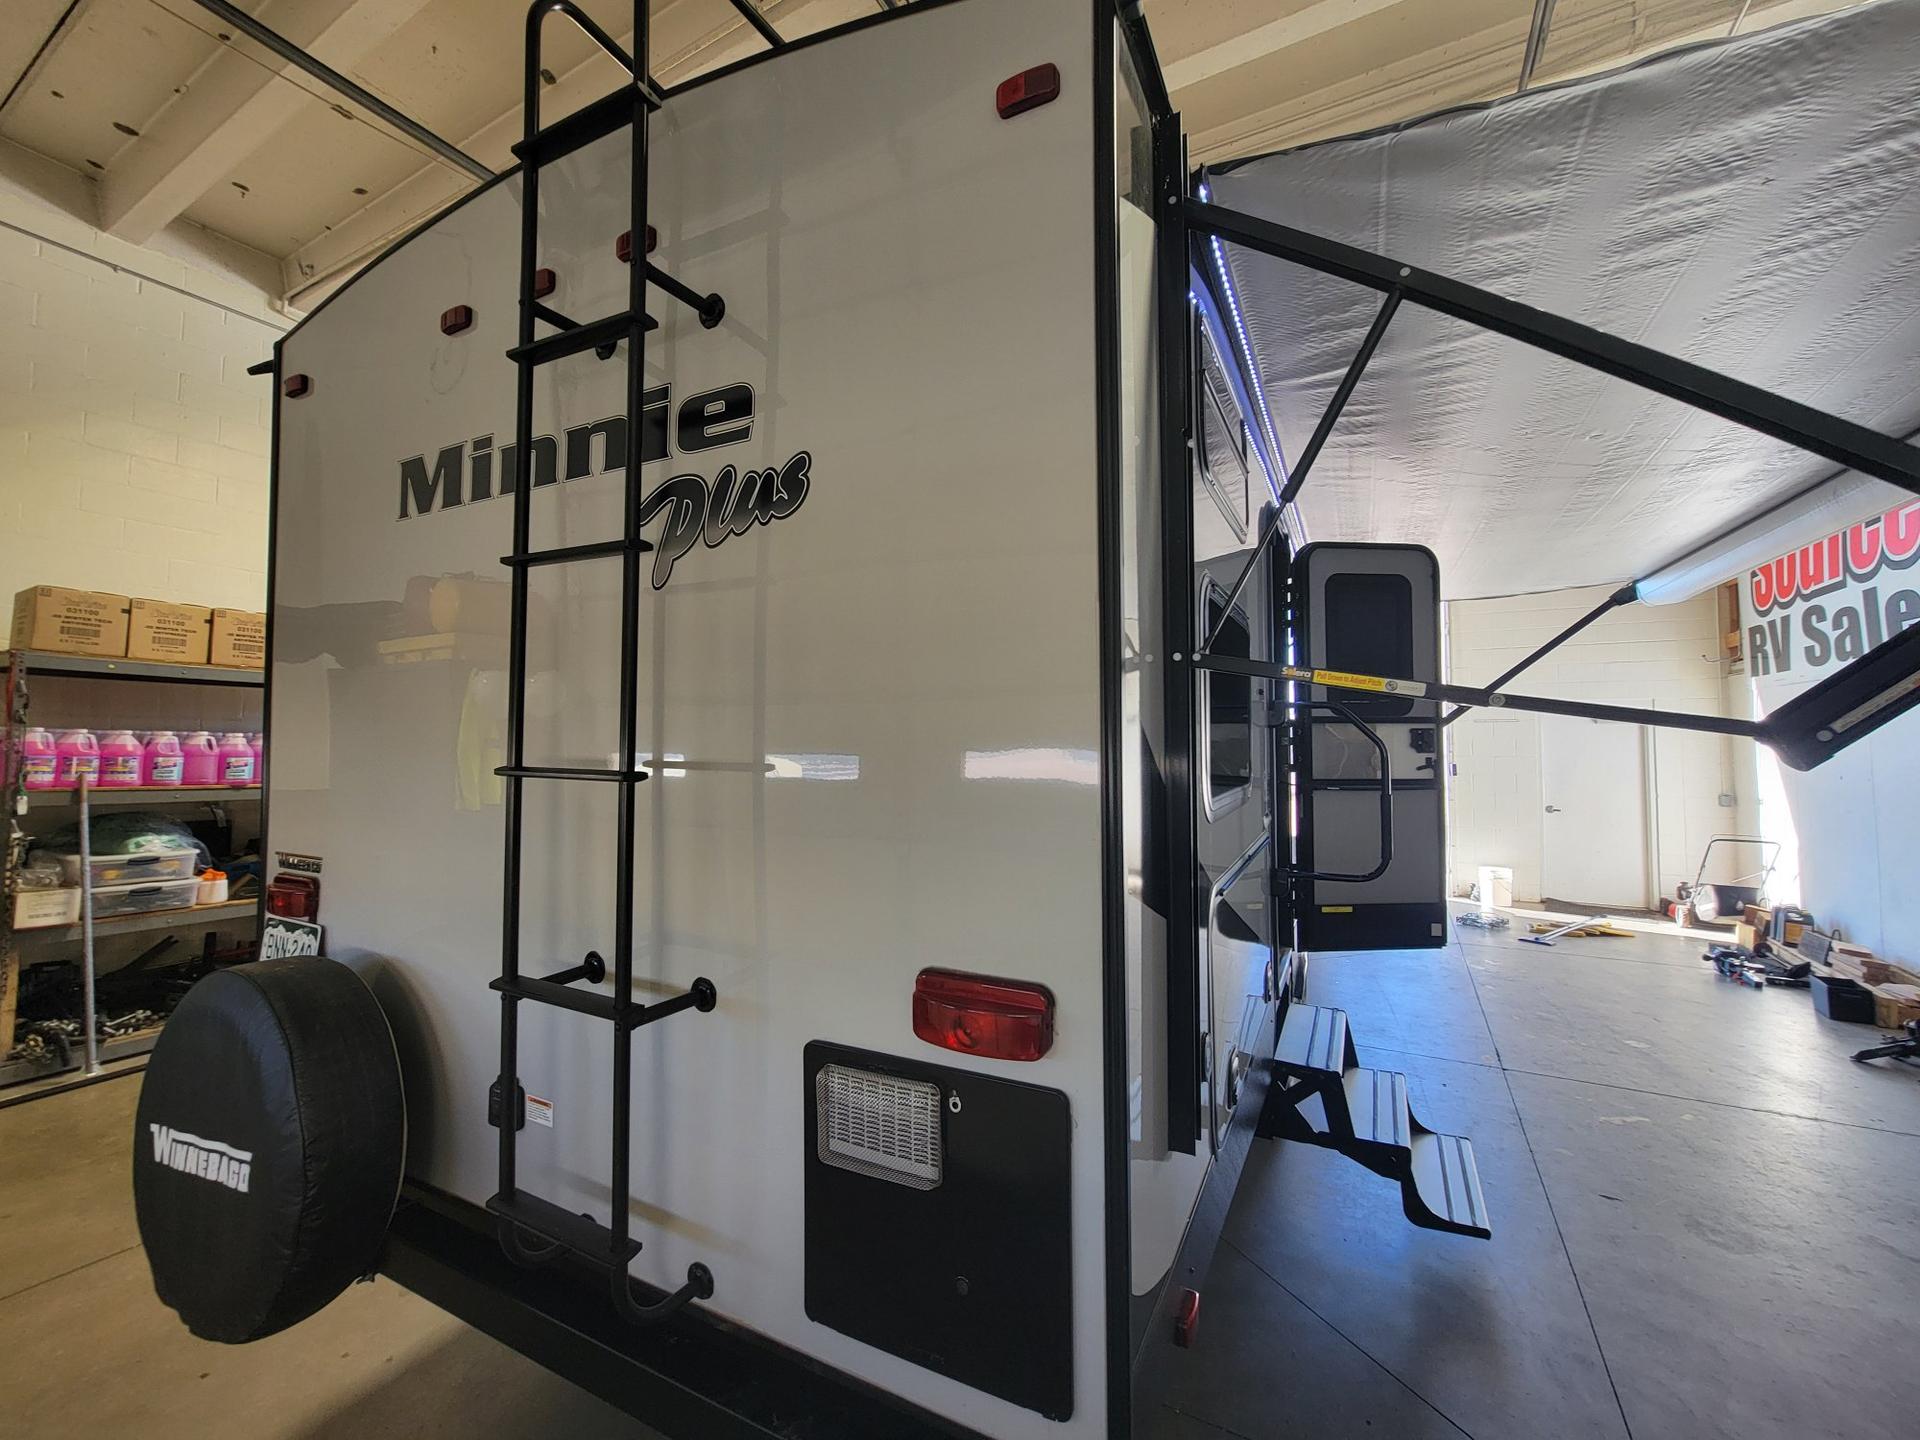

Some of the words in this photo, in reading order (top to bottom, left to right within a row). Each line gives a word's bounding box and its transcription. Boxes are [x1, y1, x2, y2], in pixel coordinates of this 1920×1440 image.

[396, 381, 756, 522] Minnie
[1748, 614, 1792, 677] RV
[1801, 586, 1920, 667] Sale
[150, 1123, 253, 1193] WINNEBAGO
